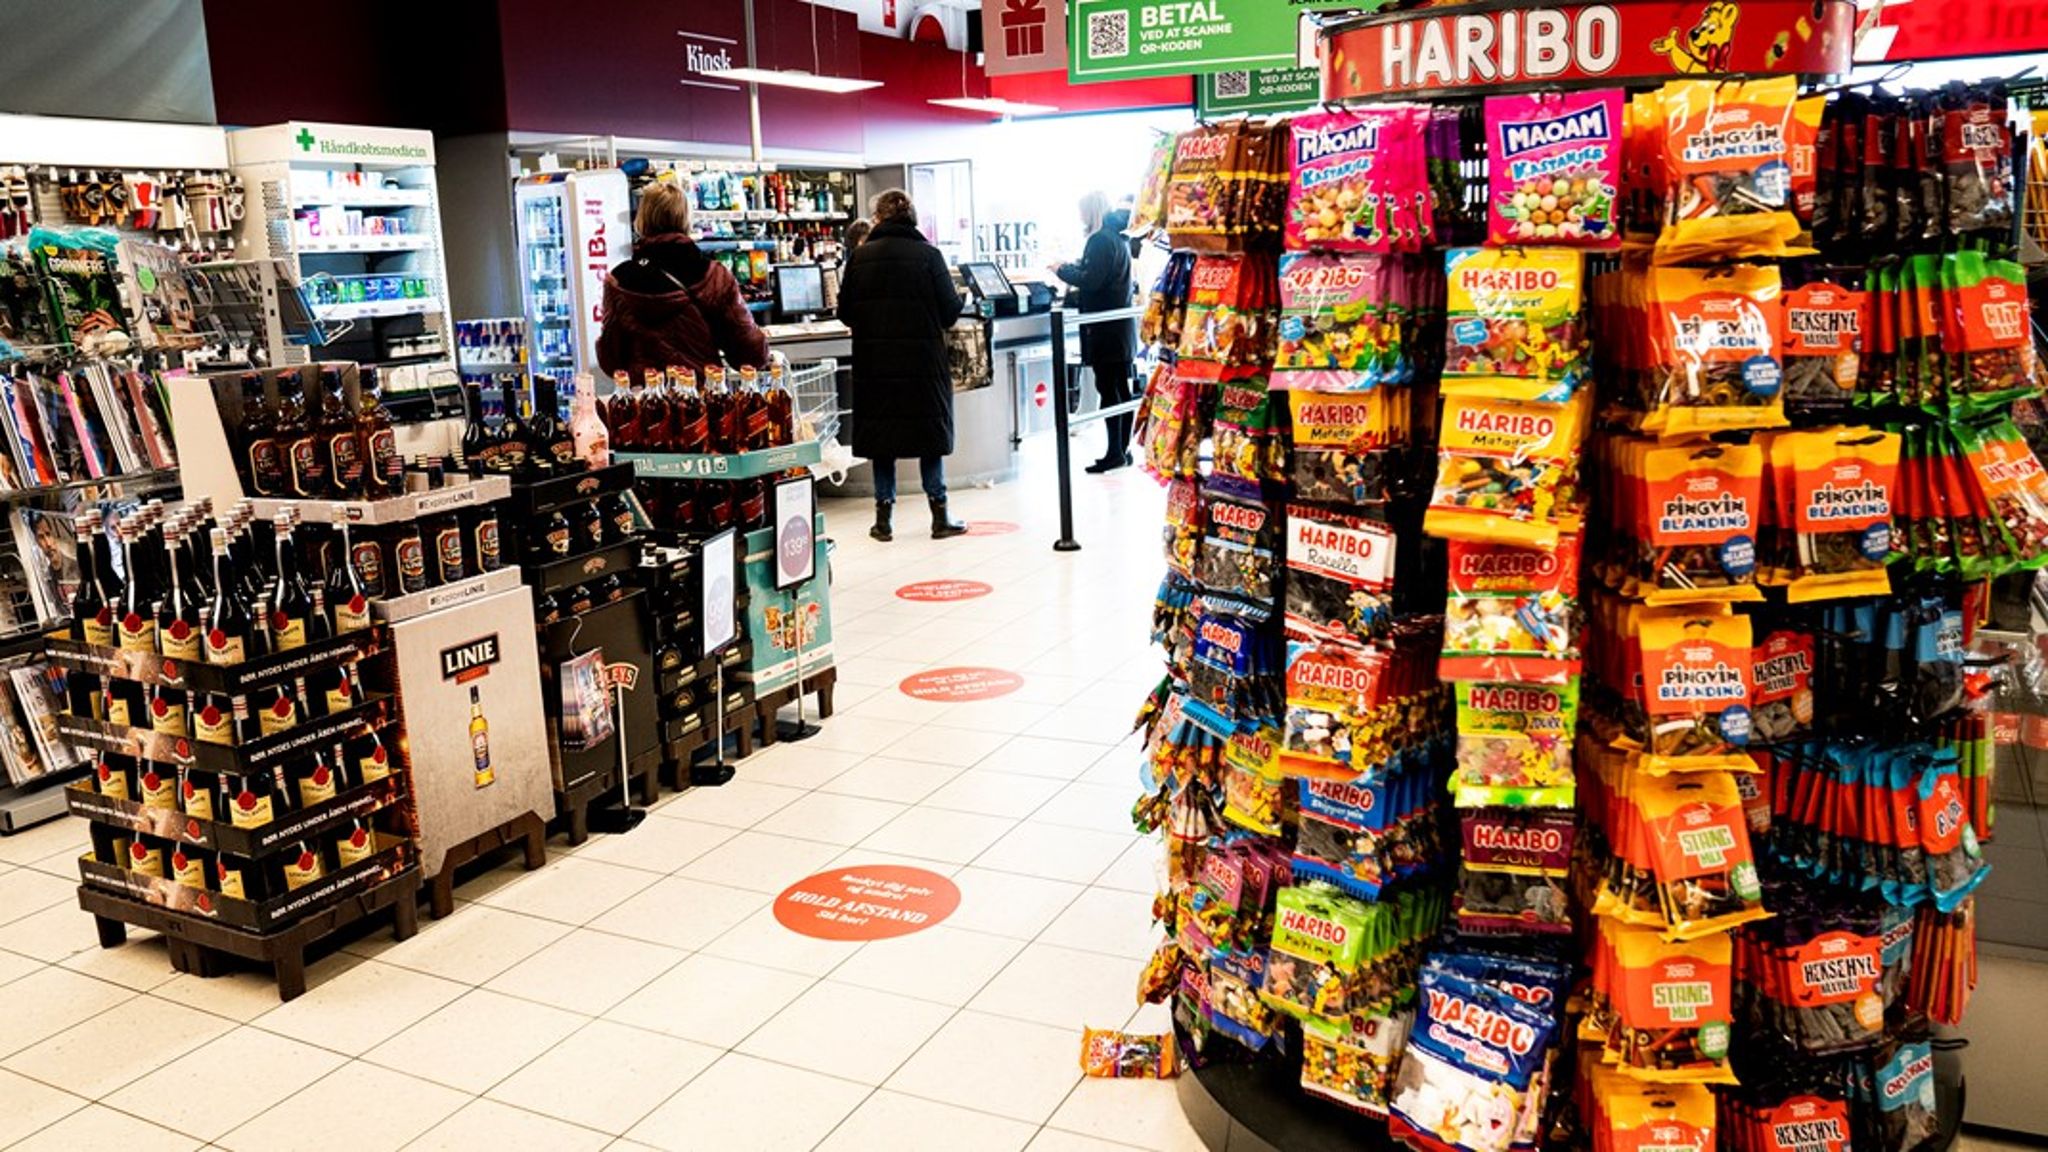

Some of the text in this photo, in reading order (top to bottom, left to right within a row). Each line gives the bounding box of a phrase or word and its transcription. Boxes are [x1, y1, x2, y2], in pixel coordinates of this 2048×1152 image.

[1141, 0, 1225, 28] BETAL
[1140, 40, 1202, 54] QR-KODEN
[1141, 29, 1164, 41] VED
[1166, 28, 1180, 38] AT
[1382, 5, 1619, 87] HARIBO
[686, 43, 733, 74] Kiosk
[1300, 124, 1376, 160] MAOAM
[1509, 113, 1604, 153] MAOAM
[1689, 123, 1778, 147] PINGVIN
[1461, 269, 1560, 293] HARIBO
[1298, 403, 1369, 425] HARIBO
[1459, 408, 1556, 438] HARIBO
[1666, 492, 1744, 516] PINGVIN
[1813, 481, 1885, 504] PINGVIN
[1661, 515, 1748, 531] BLANDING
[1808, 503, 1889, 518] BLANDING
[1298, 525, 1373, 559] HARIBO
[1460, 554, 1558, 577] HARIBO
[283, 658, 308, 671] UNDER
[445, 640, 496, 674] LINIE
[1297, 662, 1369, 691] HARIBO
[1664, 664, 1739, 684] PINGVIN
[1470, 689, 1560, 713] HARIBO
[1660, 684, 1744, 698] BLANDING
[1309, 778, 1373, 811] HARIBO
[1474, 825, 1562, 851] HARIBO
[788, 891, 929, 924] HOLD AFSTAND
[1282, 910, 1347, 944] HARIBO
[1803, 956, 1876, 983] HEKSEHYL
[1428, 990, 1535, 1056] HARIBO
[1776, 1120, 1843, 1145] HEKSEHYL
